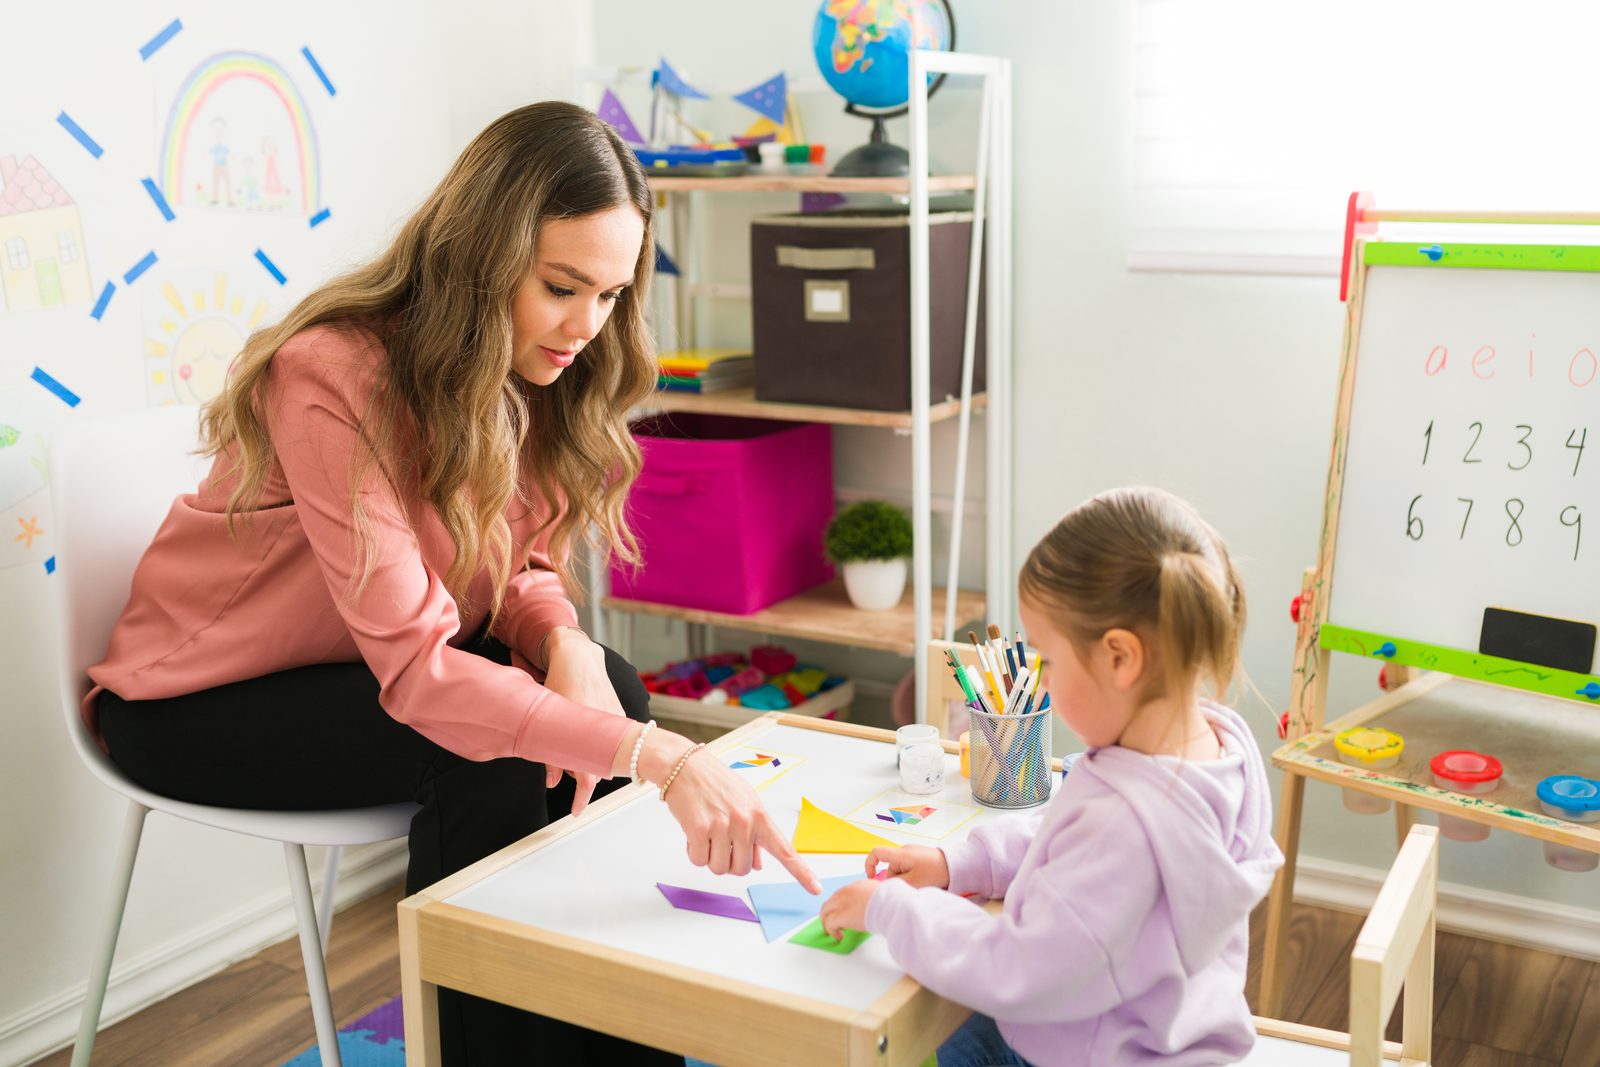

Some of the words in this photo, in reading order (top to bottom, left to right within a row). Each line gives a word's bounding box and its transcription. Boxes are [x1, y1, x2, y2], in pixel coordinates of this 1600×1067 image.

[1424, 345, 1449, 377] a
[1471, 345, 1497, 381] e
[1528, 332, 1537, 379] i
[1568, 347, 1598, 388] o
[1422, 419, 1434, 466] 1
[1462, 421, 1483, 464] 2
[1507, 424, 1533, 471] 3
[1565, 427, 1588, 477] 4
[1405, 494, 1425, 542] 6
[1457, 497, 1475, 541] 7
[1504, 498, 1525, 547] 8
[1559, 505, 1582, 561] 9
